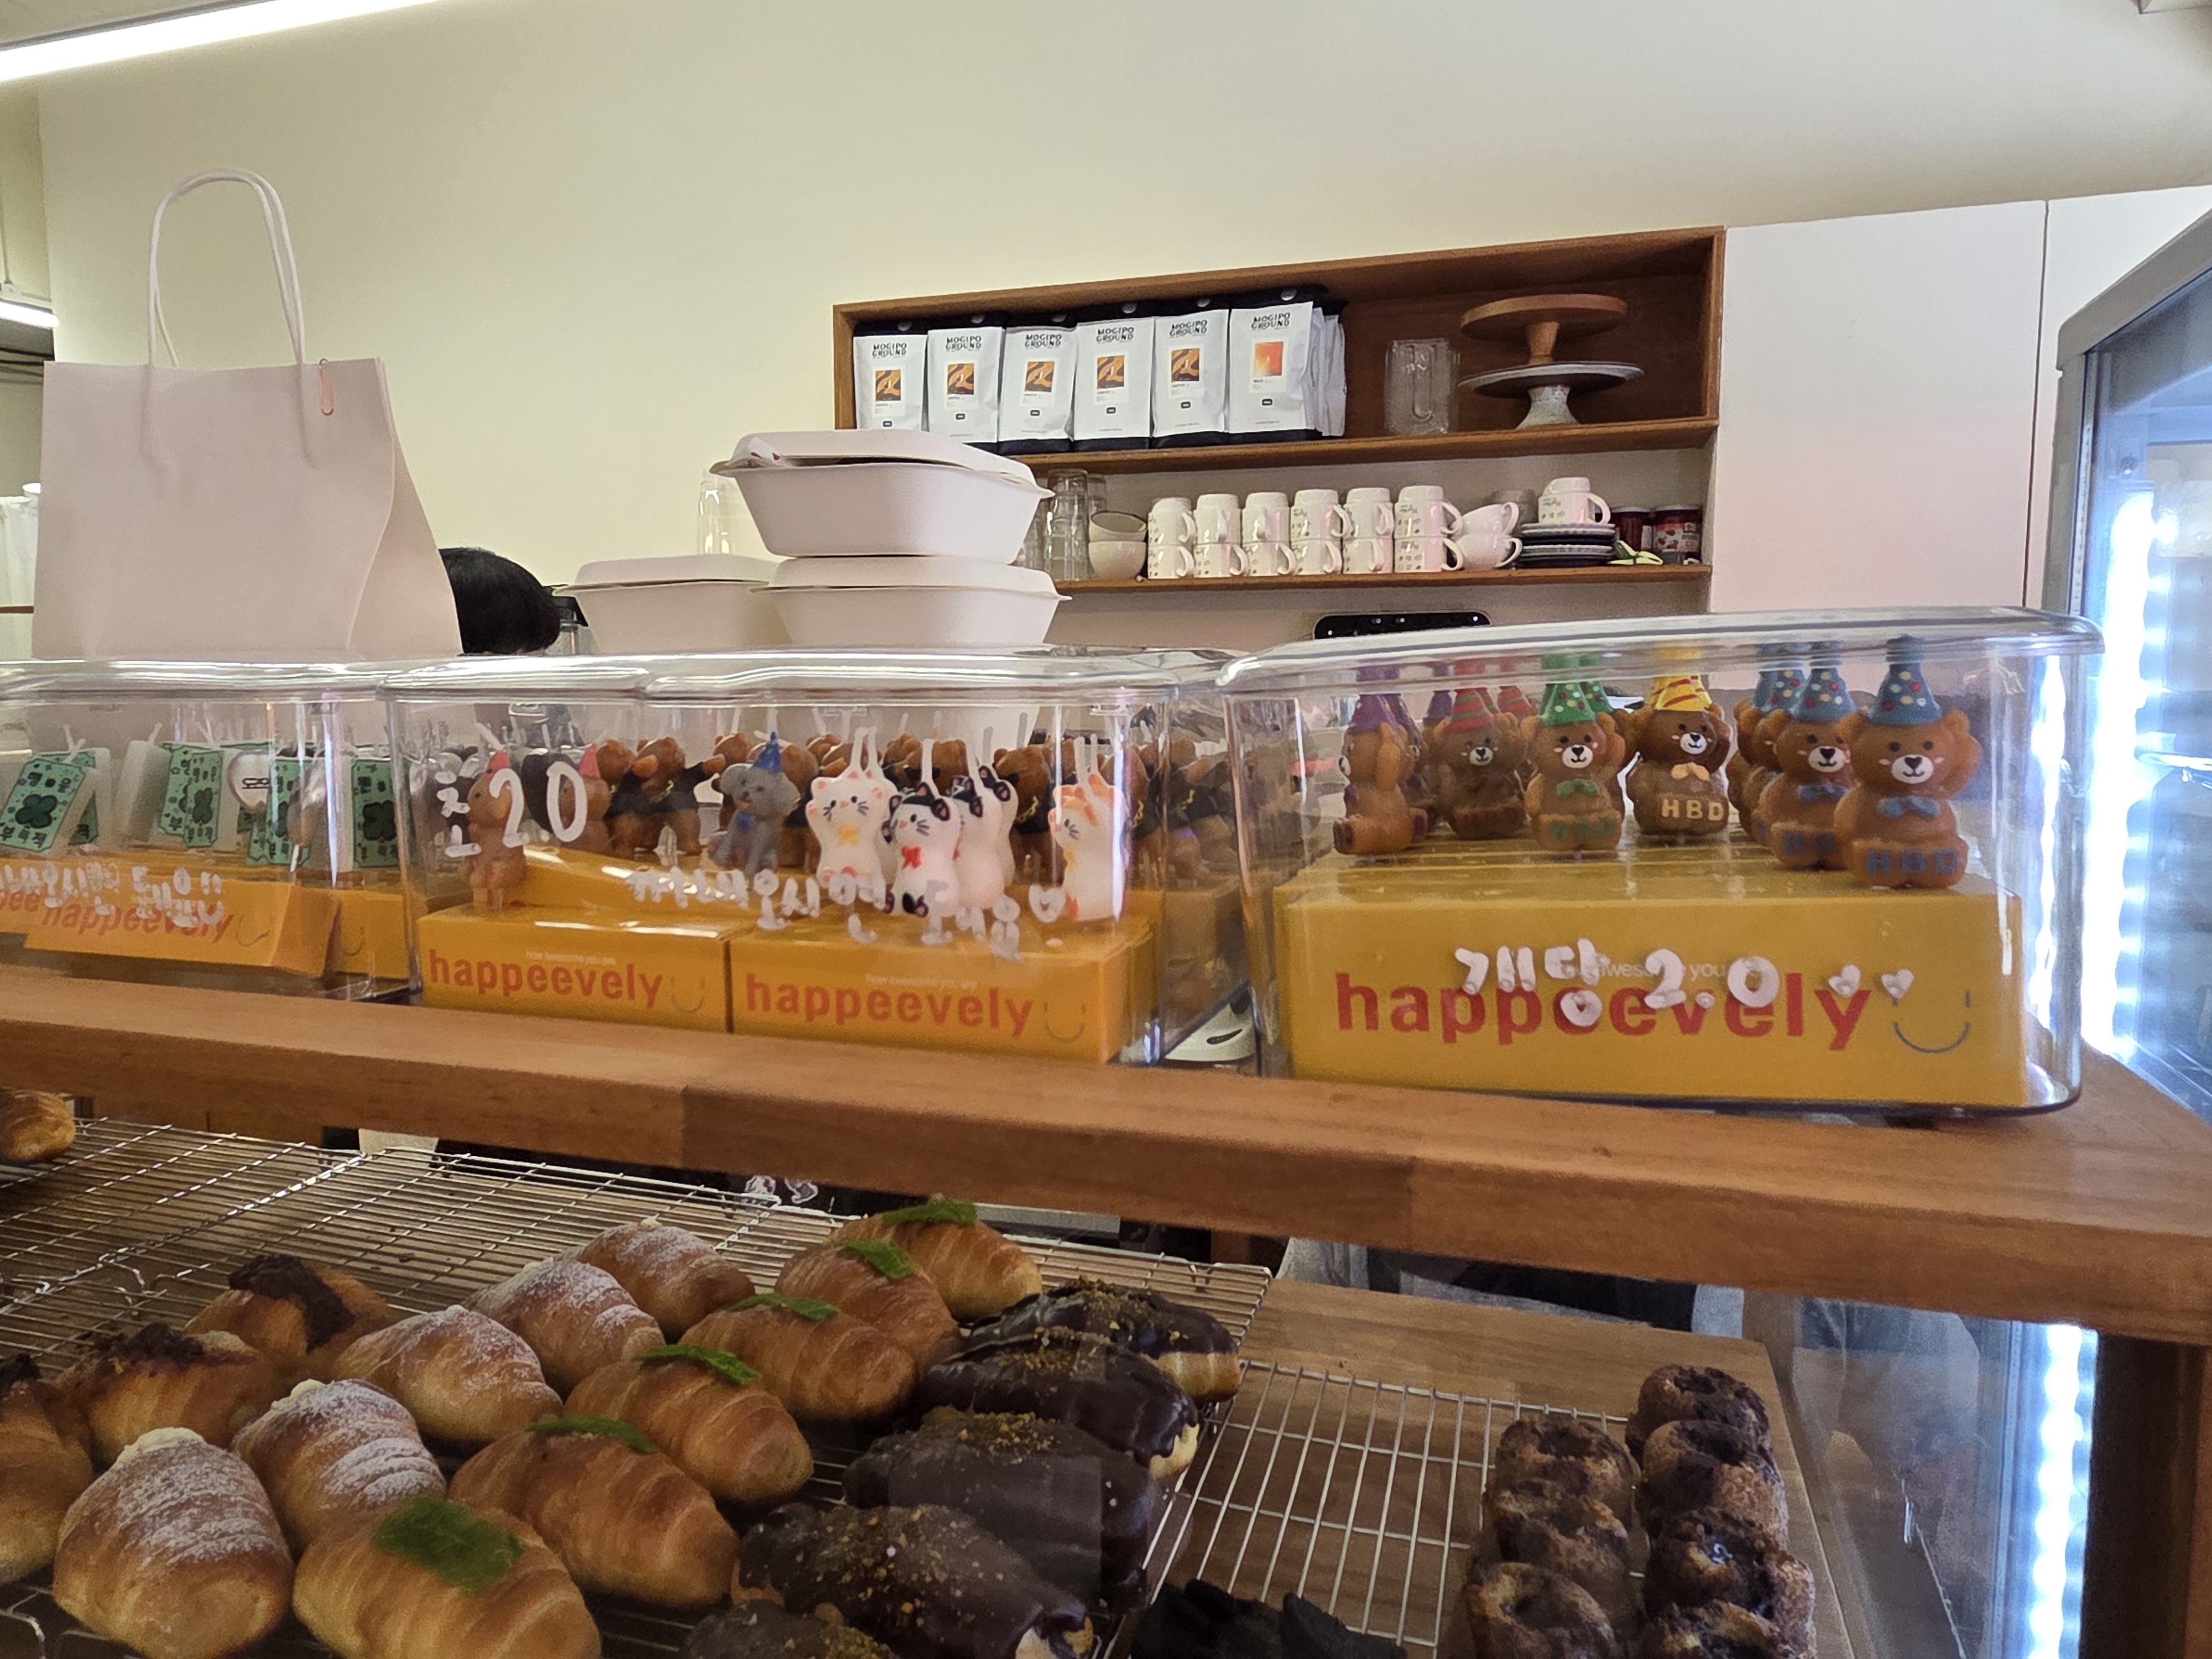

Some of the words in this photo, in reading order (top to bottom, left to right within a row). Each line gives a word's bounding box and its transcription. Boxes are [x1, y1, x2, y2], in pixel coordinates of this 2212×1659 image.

[1253, 312, 1291, 323] MOGIPO
[1171, 319, 1208, 329] MOGIPO
[1250, 319, 1290, 330] GROUND
[1097, 326, 1135, 335] MOGIPO
[1169, 327, 1207, 337] GROUND
[1096, 333, 1134, 342] GROUND
[945, 342, 982, 351] GROUND
[1024, 340, 1061, 348] GROUND
[1661, 798, 1724, 821] HBD
[1866, 848, 1958, 875] HBD
[427, 948, 663, 1007] happeevely
[1454, 937, 1611, 1027] 개당
[1644, 948, 1781, 1009] 2.0
[745, 974, 1033, 1037] happeevely
